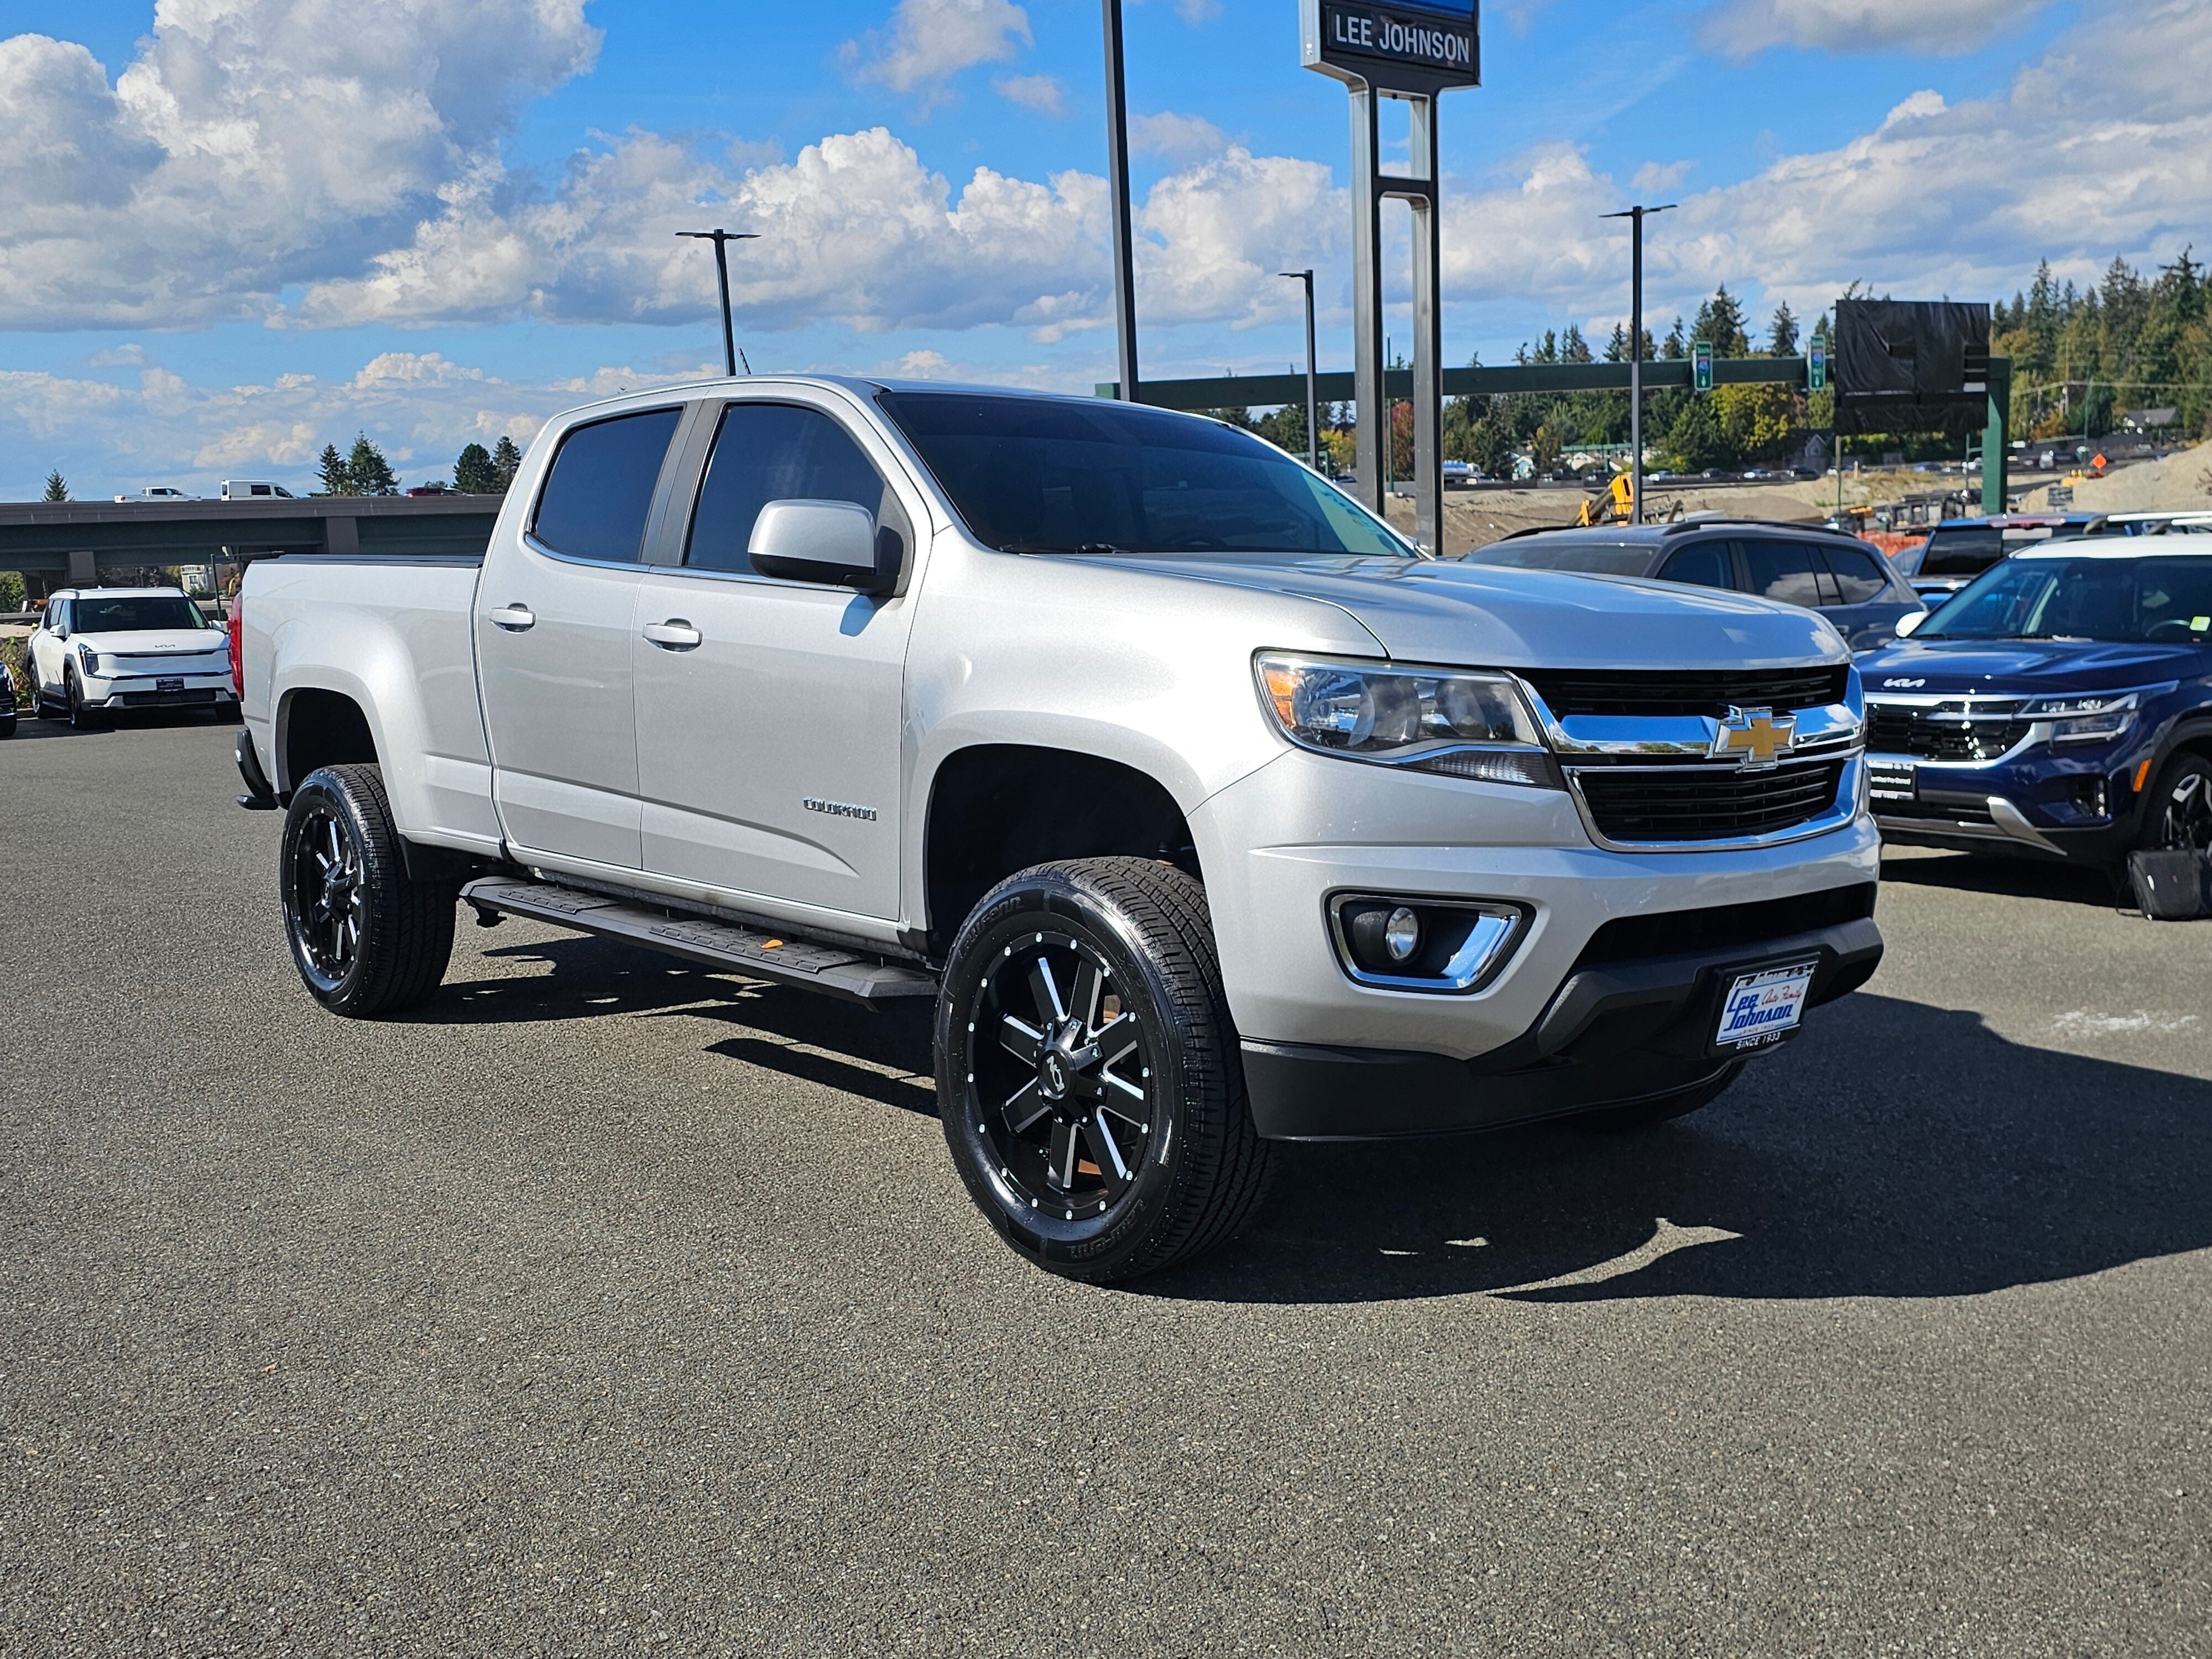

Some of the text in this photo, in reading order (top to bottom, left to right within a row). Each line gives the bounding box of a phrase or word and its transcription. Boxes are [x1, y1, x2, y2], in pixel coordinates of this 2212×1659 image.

[1336, 14, 1469, 63] LEE JOHNSON
[804, 797, 876, 821] COLORADO
[1726, 988, 1760, 1013] Lee
[1723, 1004, 1793, 1032] Johnson
[1736, 1039, 1759, 1050] SINCE
